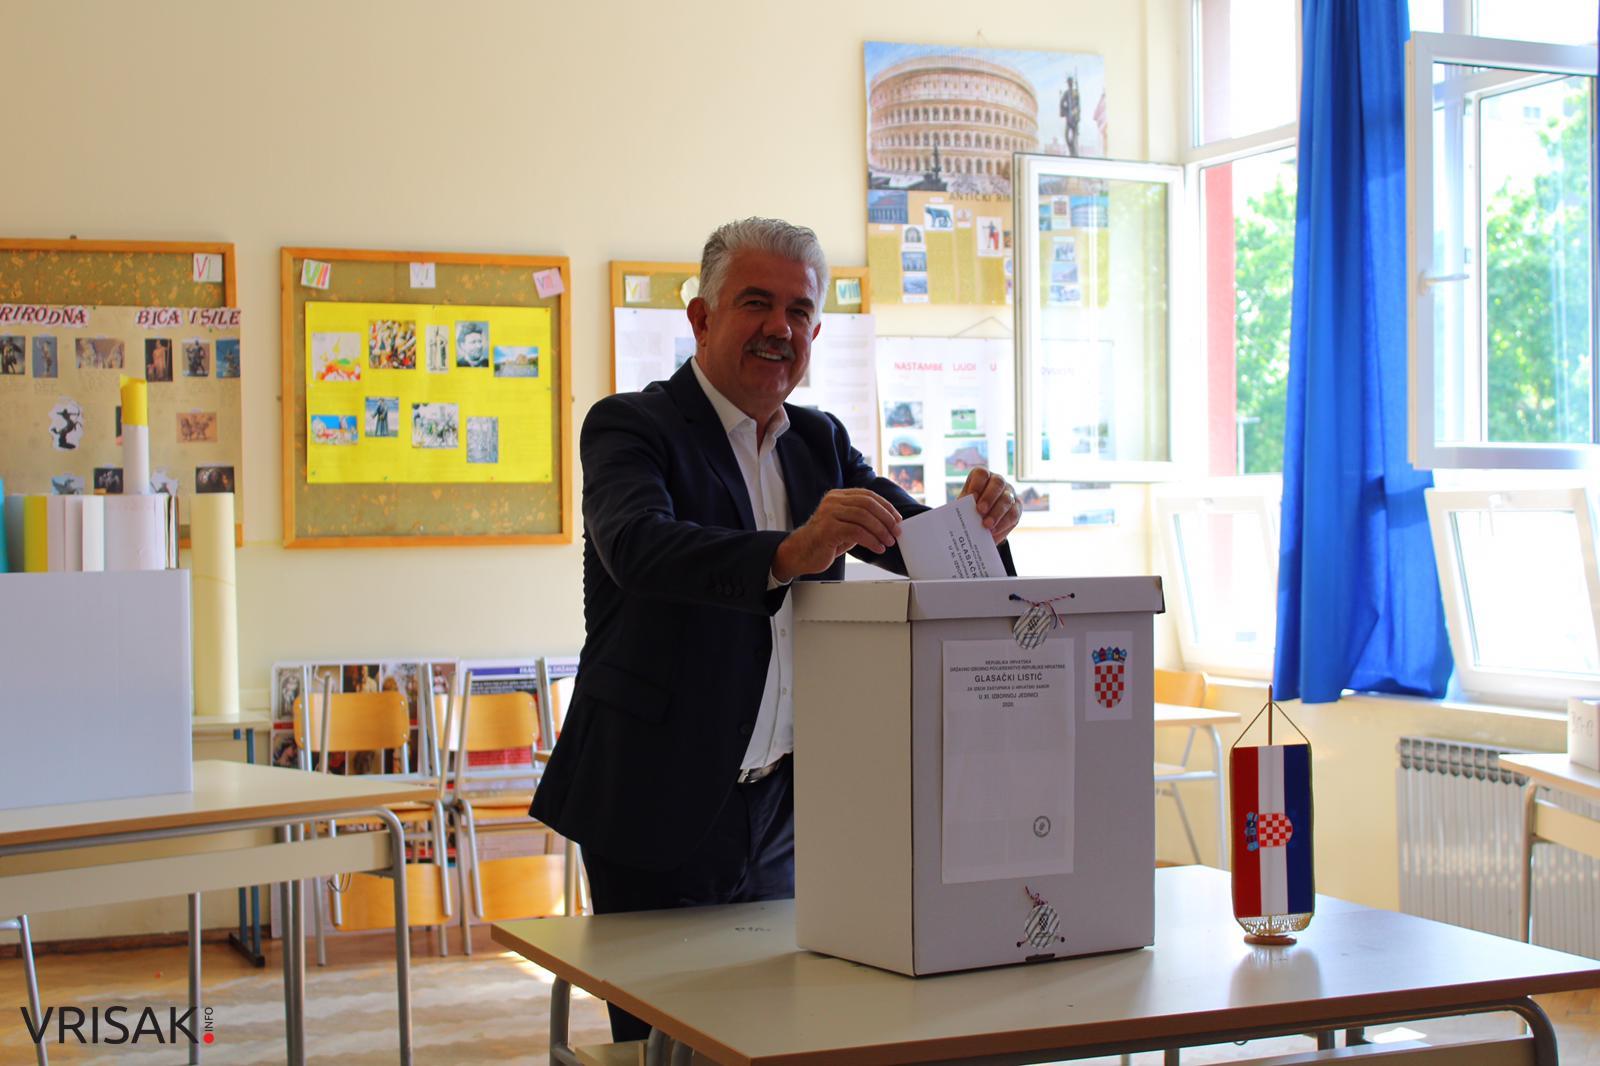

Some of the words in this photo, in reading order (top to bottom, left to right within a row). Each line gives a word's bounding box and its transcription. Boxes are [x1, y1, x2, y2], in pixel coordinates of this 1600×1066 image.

[0, 305, 86, 325] RIRODNA
[894, 361, 944, 372] NASTAMBE
[974, 673, 1015, 683] GLASAČKI
